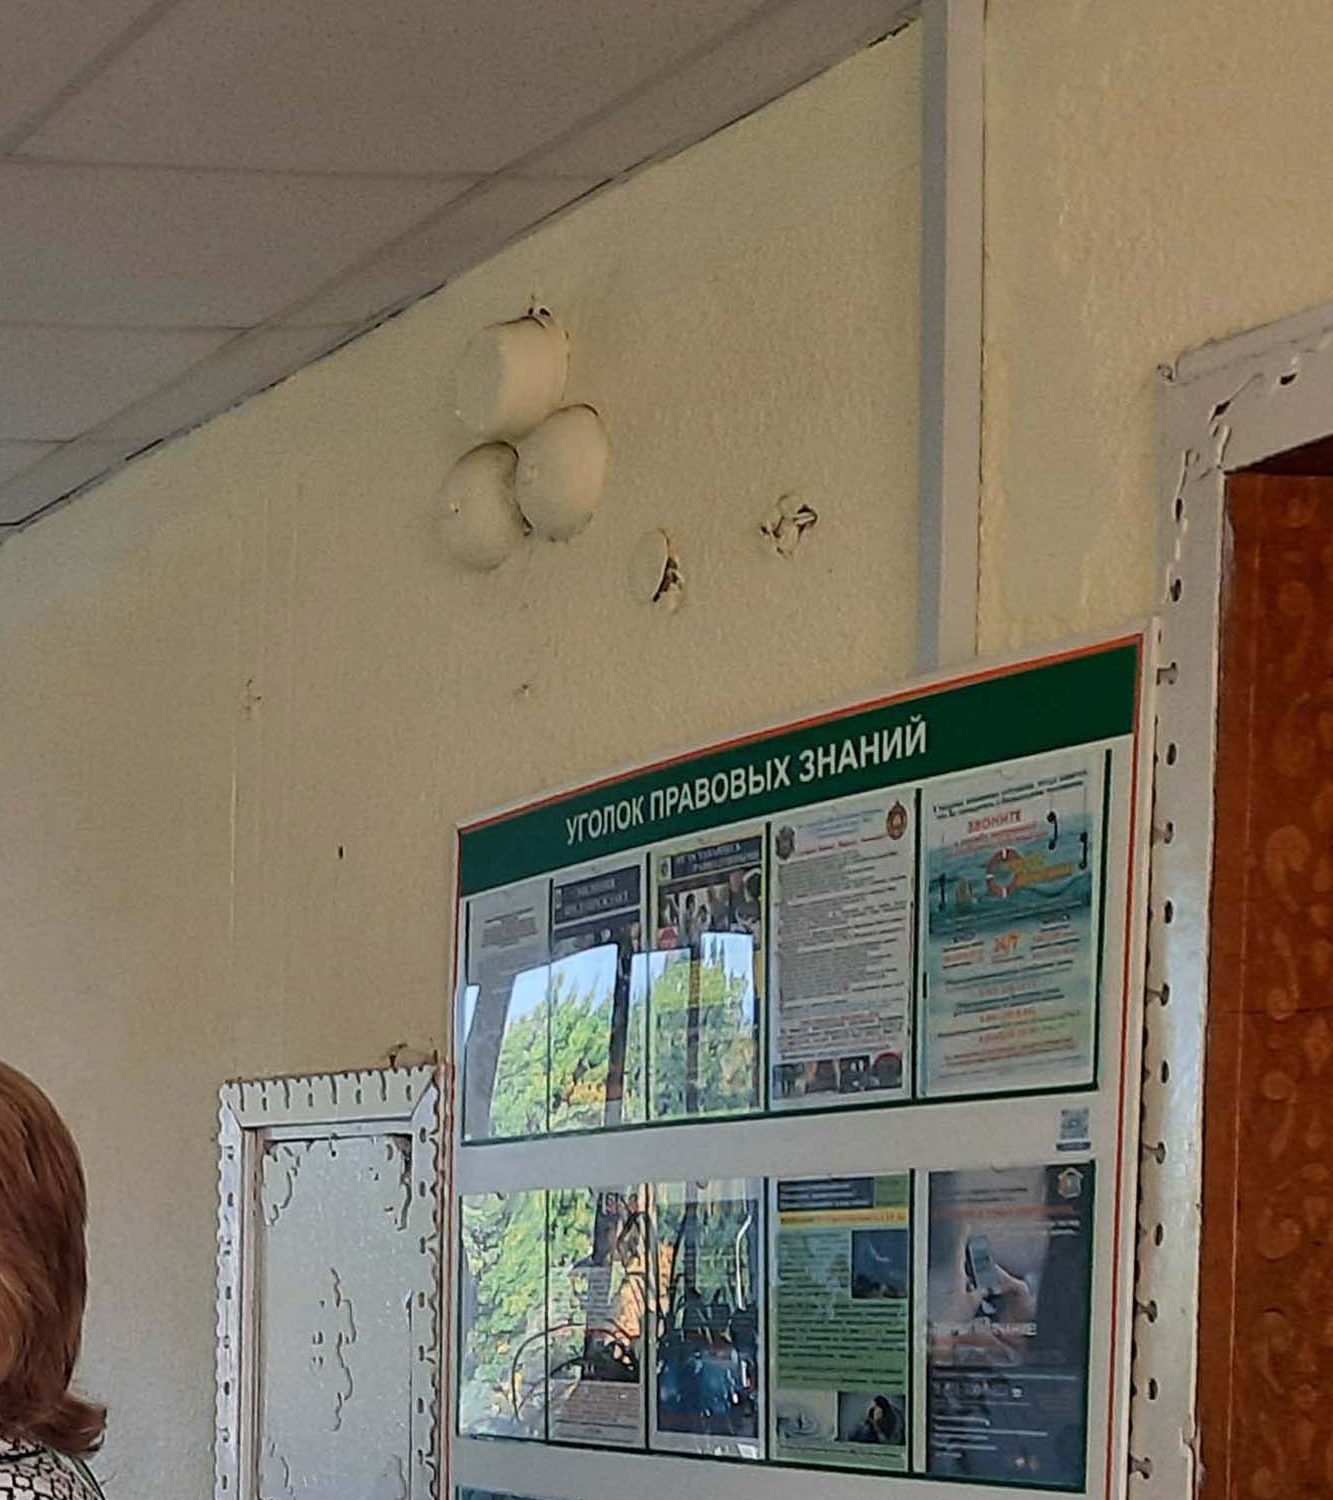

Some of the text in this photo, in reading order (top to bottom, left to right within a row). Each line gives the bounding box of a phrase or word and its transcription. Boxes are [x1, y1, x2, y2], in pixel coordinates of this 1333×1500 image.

[565, 714, 927, 846] УГОЛОК ПРАВОВЫХ ЗНАНИЙ
